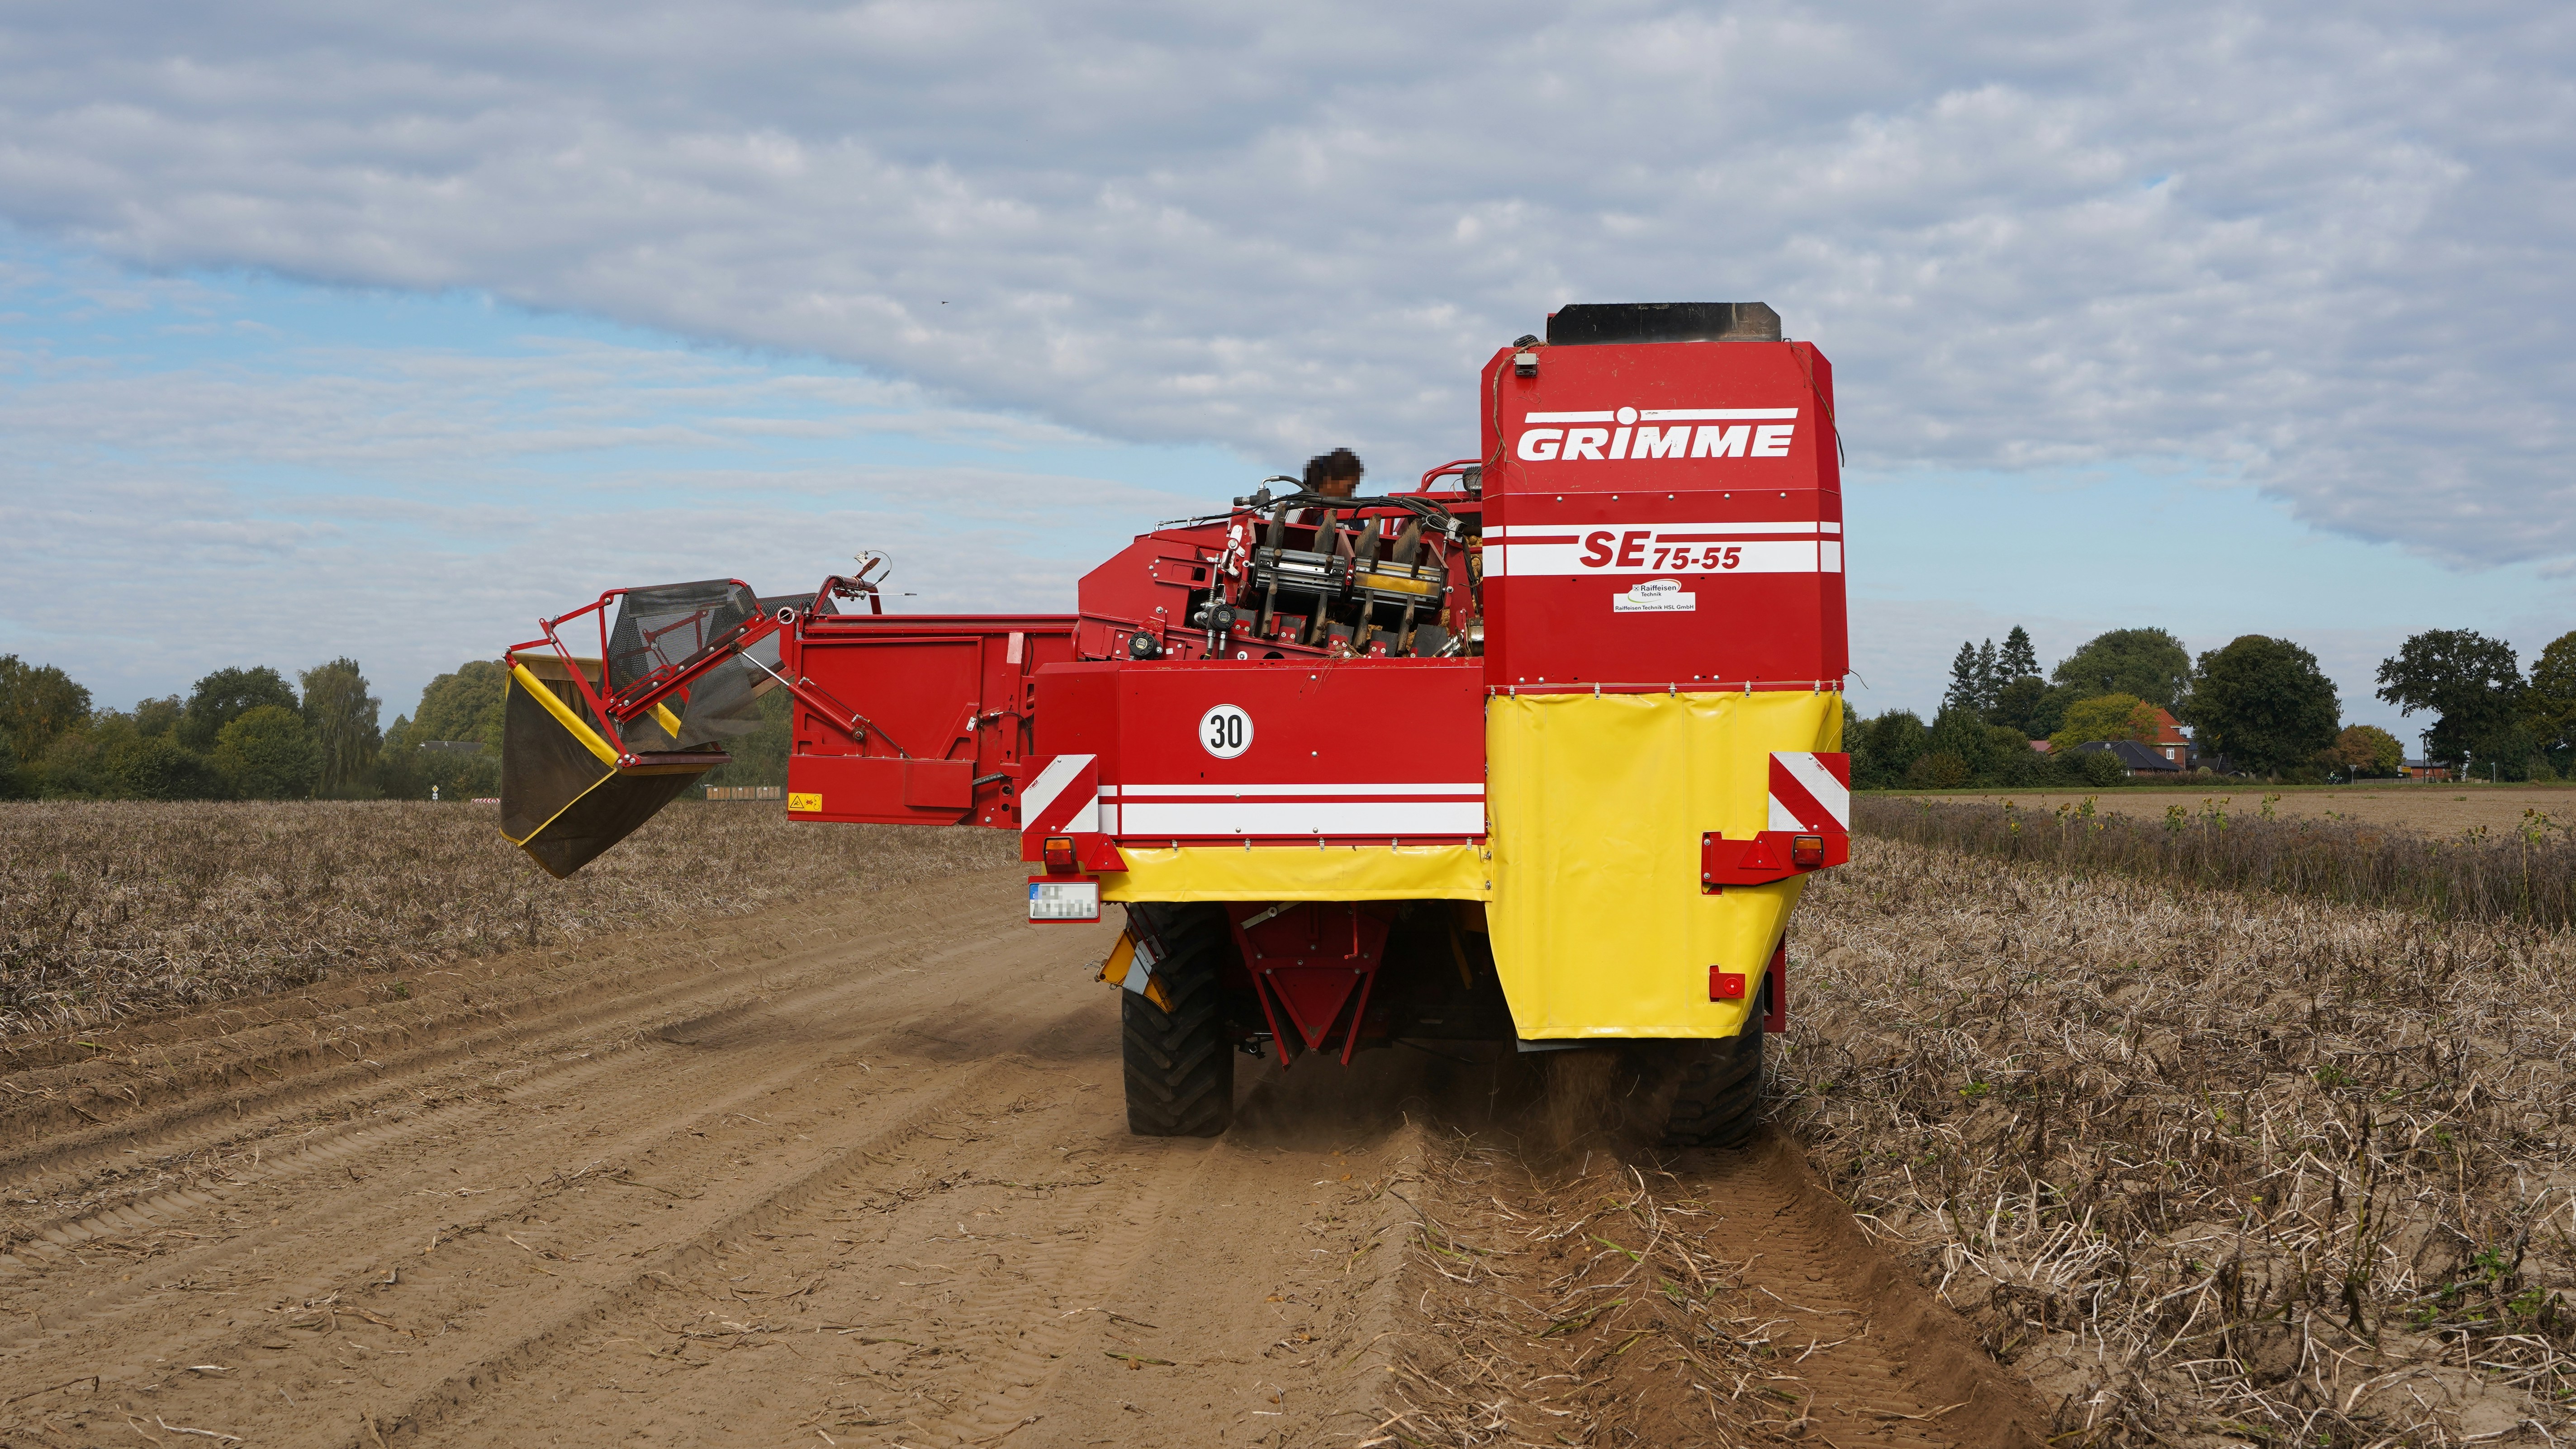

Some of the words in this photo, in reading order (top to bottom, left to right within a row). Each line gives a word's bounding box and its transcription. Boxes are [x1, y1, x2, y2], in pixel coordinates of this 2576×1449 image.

[1518, 407, 1795, 461] GRIMME
[1580, 531, 1651, 568] SE
[1652, 547, 1746, 570] 75-55
[1211, 715, 1242, 748] 30
